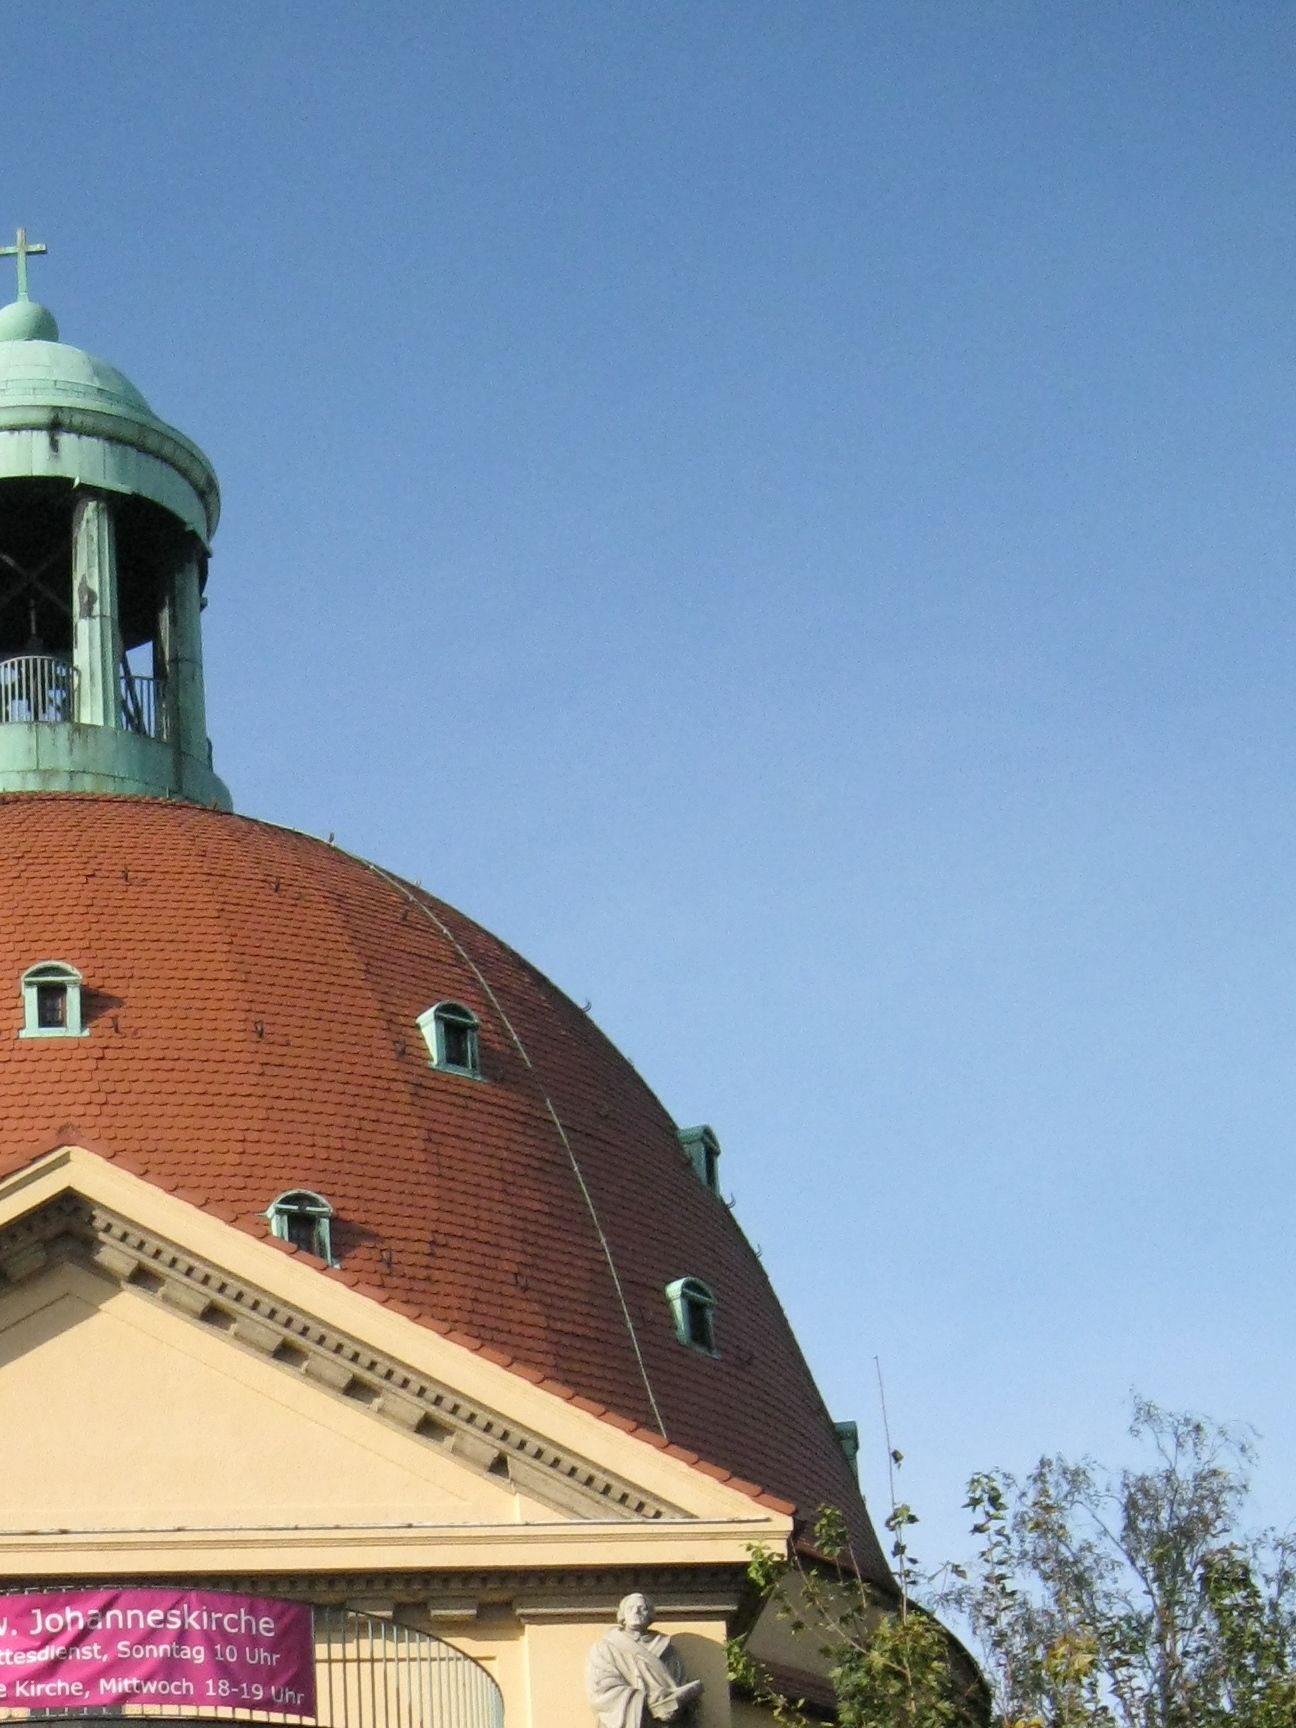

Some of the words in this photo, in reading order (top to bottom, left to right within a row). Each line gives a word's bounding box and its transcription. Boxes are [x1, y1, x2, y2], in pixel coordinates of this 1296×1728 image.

[30, 1604, 275, 1637] Johanneskirche
[117, 1640, 204, 1664] Sonntag
[214, 1643, 238, 1662] 10
[246, 1646, 281, 1666] Uhr
[16, 1679, 91, 1699] Kirche,
[99, 1677, 194, 1696] Mittwoch
[205, 1678, 264, 1700] 18-19
[271, 1685, 305, 1705] Uhr
